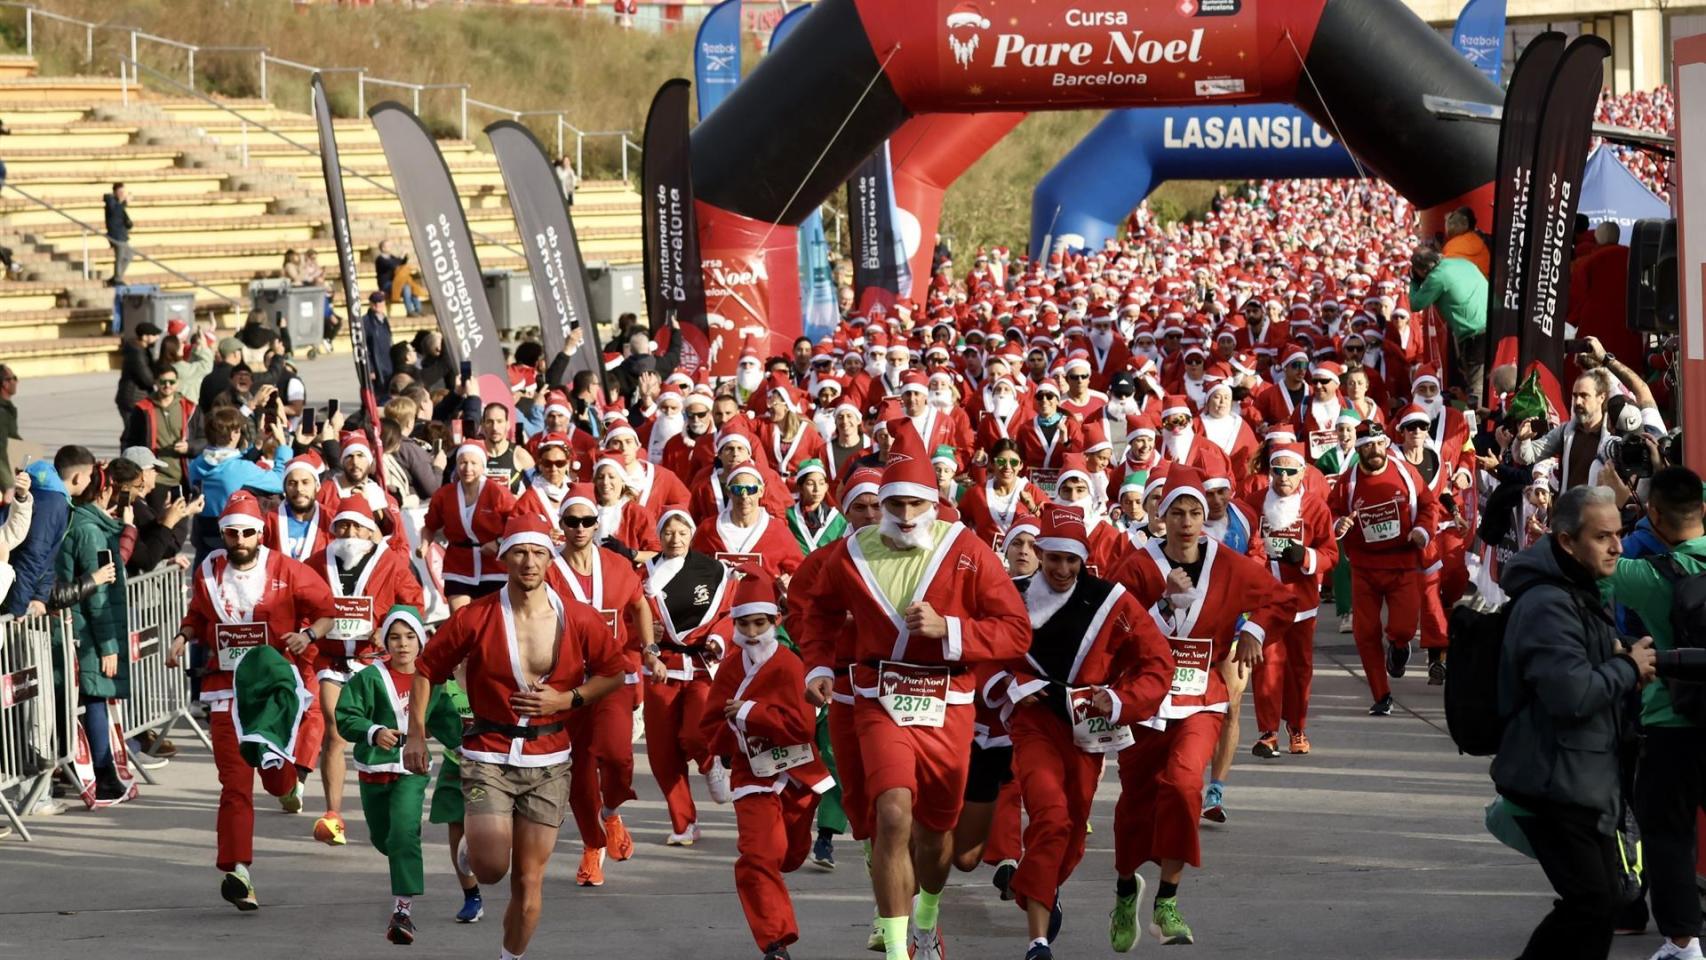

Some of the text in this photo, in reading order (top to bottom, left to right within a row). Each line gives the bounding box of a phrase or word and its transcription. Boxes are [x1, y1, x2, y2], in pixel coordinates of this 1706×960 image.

[1065, 9, 1128, 27] Cursa
[991, 28, 1206, 68] Pare Noel
[1052, 72, 1148, 88] Barcelona
[868, 176, 880, 269] Barcelona
[657, 184, 673, 300] Ajuntament de
[701, 260, 722, 268] ursa
[1541, 180, 1571, 337] Barcelona
[1371, 521, 1392, 533] 1047
[336, 619, 361, 630] 1377
[1172, 649, 1208, 659] Pare Noel
[903, 676, 945, 686] Pare Noel
[893, 695, 931, 712] 2379
[771, 748, 789, 761] 85
